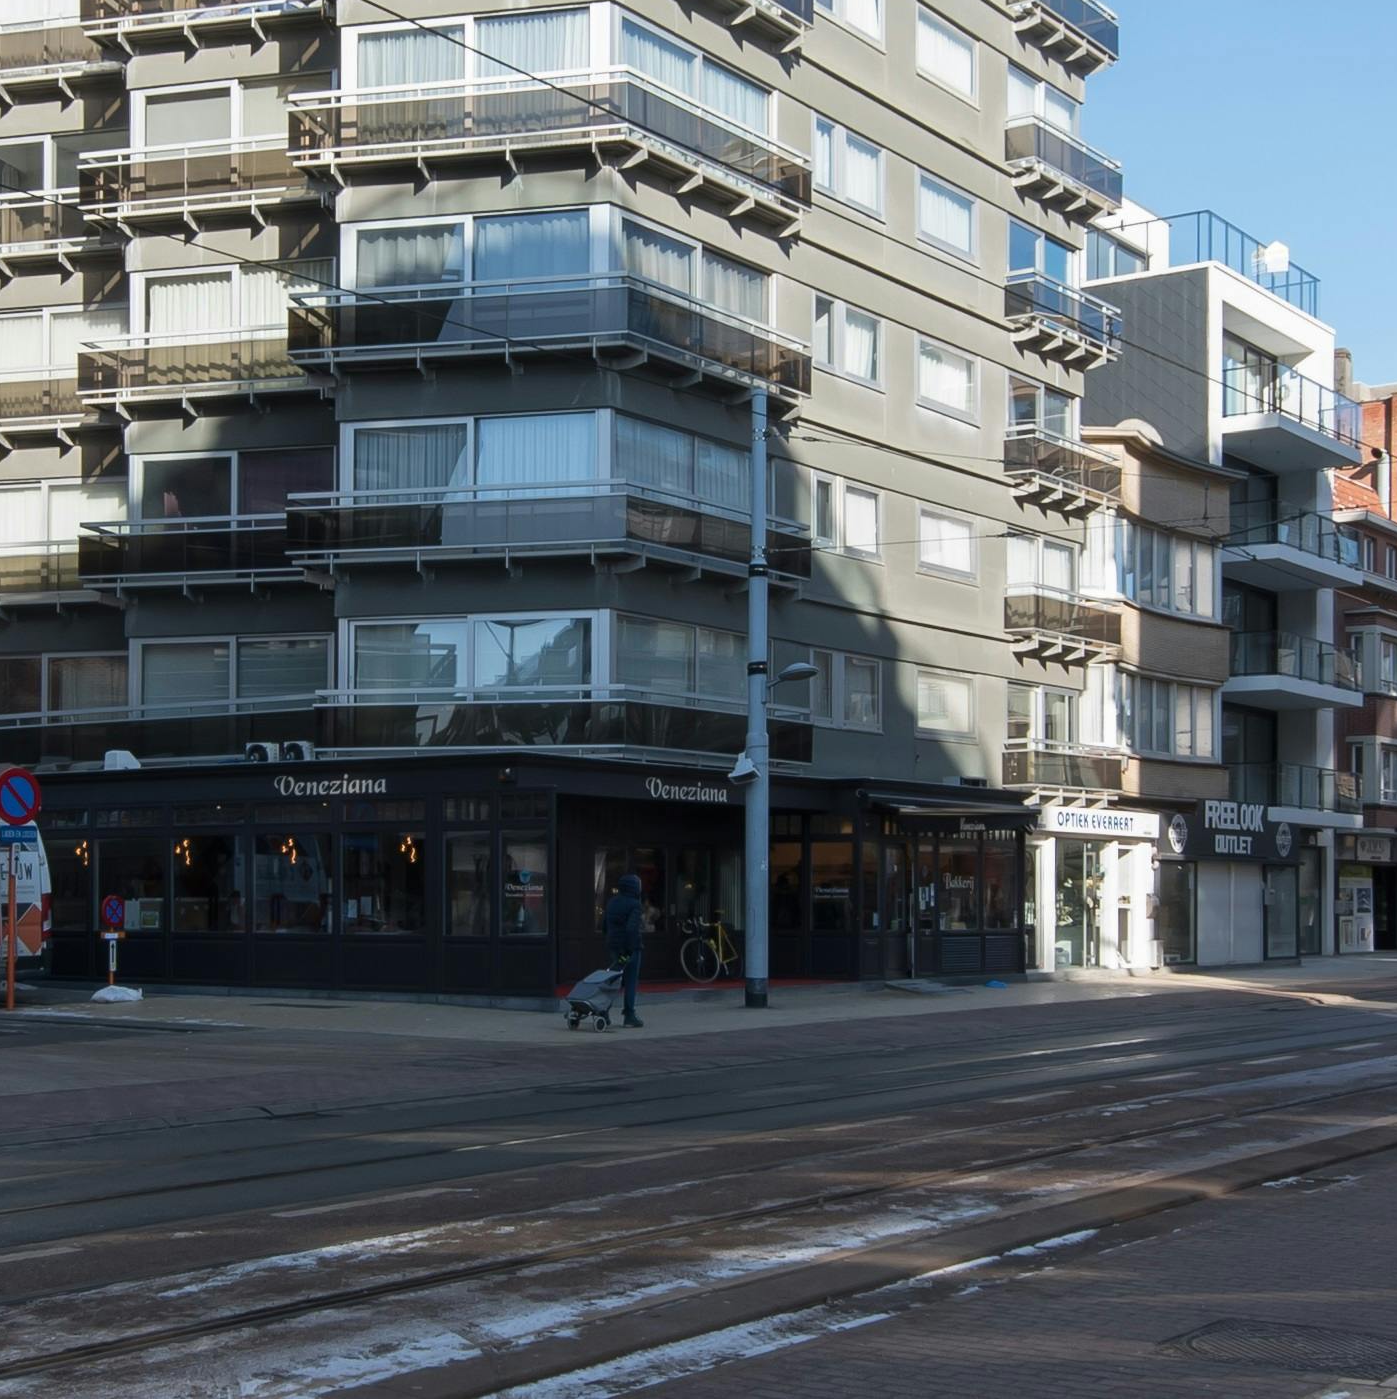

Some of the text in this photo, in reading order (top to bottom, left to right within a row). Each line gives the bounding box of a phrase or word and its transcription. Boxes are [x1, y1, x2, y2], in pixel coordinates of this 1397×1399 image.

[274, 773, 387, 796] Veneziana
[645, 776, 728, 802] Veneziana
[1057, 811, 1089, 829] OPTIEK
[1204, 799, 1264, 833] FREELOOK
[1214, 834, 1253, 855] OUTLET
